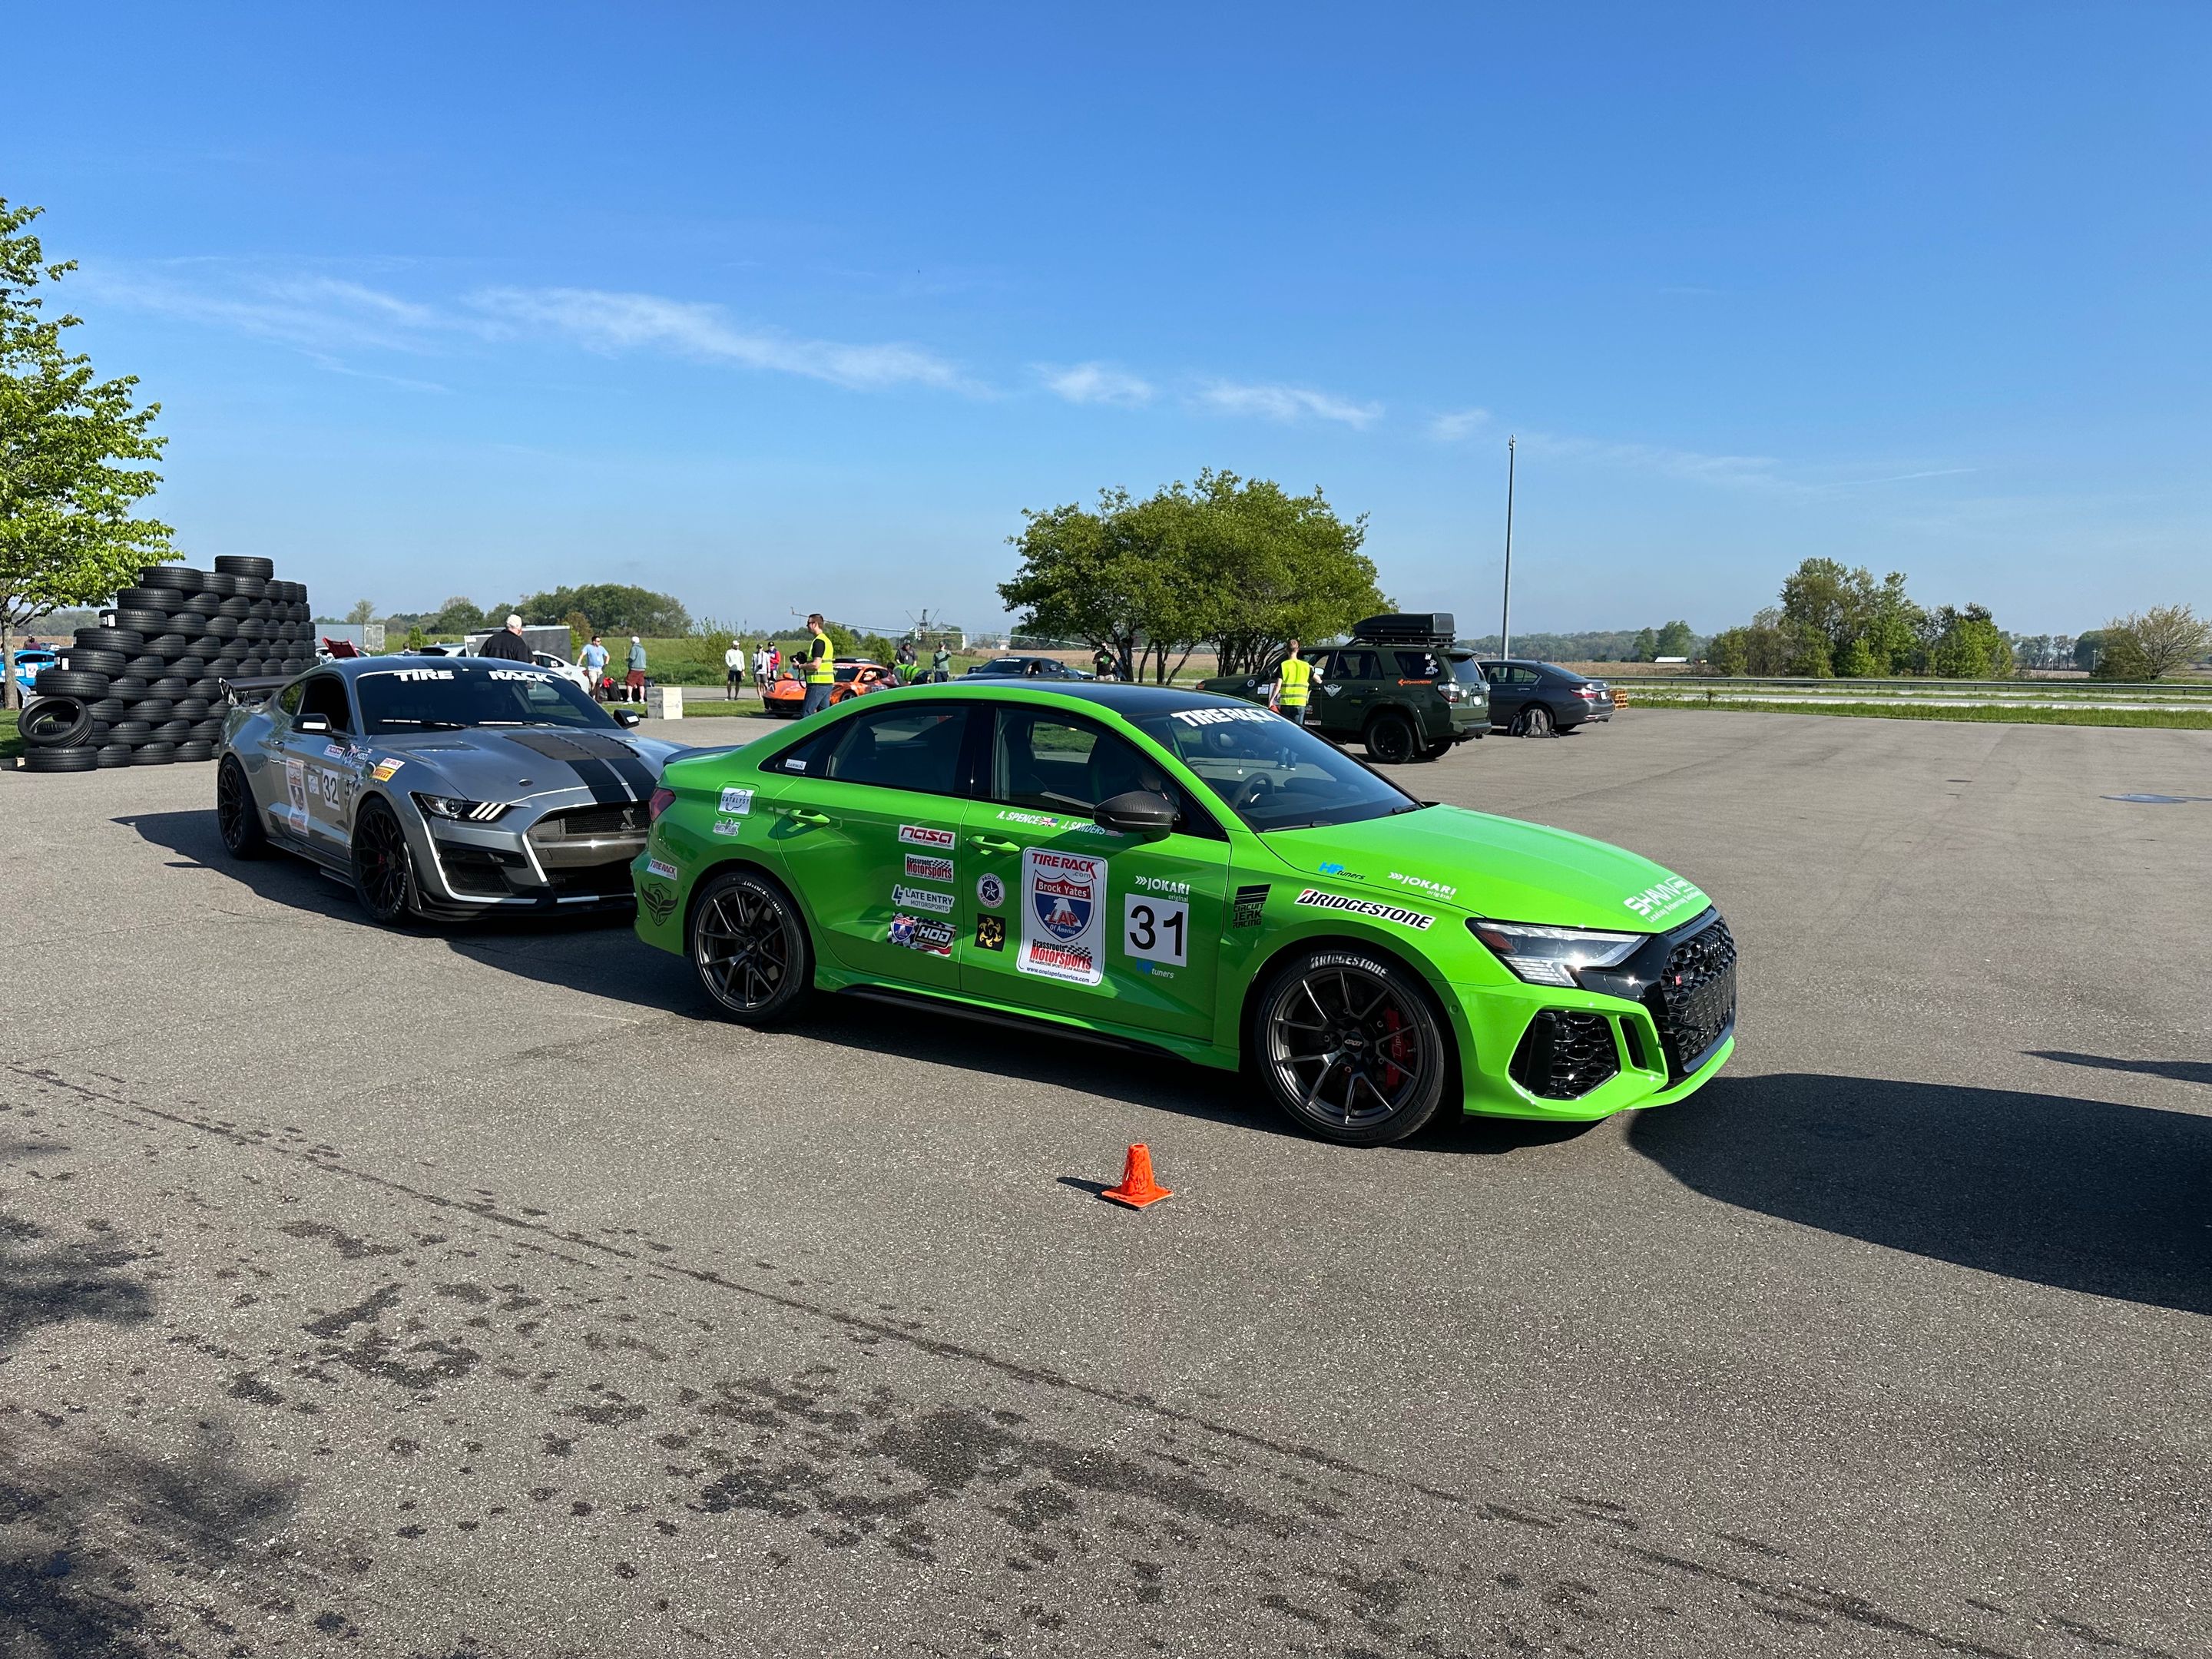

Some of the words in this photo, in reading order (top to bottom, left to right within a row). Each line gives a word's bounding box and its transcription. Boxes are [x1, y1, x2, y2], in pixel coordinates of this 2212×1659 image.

[394, 670, 454, 681] TIRE
[488, 671, 553, 683] RACK
[1170, 708, 1233, 727] TIRE
[1223, 708, 1281, 723] RACK
[323, 775, 339, 804] 32
[722, 796, 750, 805] CATALYST
[996, 810, 1005, 820] A.
[1005, 812, 1041, 825] SPENCE
[1060, 820, 1068, 830] J.
[1068, 822, 1105, 835] SANDERS
[901, 827, 953, 843] nasa
[907, 862, 952, 879] Motorsports
[1032, 853, 1060, 867] TIRE
[1060, 858, 1097, 879] RACK
[1318, 861, 1344, 875] HP
[1336, 869, 1366, 880] tuners
[982, 876, 1001, 884] PROJECT
[1147, 878, 1190, 895] JOKARI
[1401, 876, 1456, 895] JOKARI
[906, 889, 925, 900] LATE
[927, 894, 952, 905] ENTRY
[1038, 881, 1061, 892] Brock
[1064, 886, 1089, 897] Yates'
[1426, 889, 1453, 900] original
[910, 899, 949, 912] MOTORSPORTS
[979, 892, 1002, 906] MOTORING
[1233, 902, 1266, 912] CIRCUIT
[1233, 909, 1262, 922] JERK
[1296, 889, 1433, 929] BRIDGESTONE
[1047, 909, 1078, 928] LAP
[1233, 919, 1261, 928] RACING
[1057, 926, 1075, 935] America
[1129, 905, 1184, 956] 31
[1032, 939, 1065, 952] Grassroots
[1030, 945, 1093, 970] Motorsports
[1311, 953, 1388, 978] BRIDGESTONE
[1026, 967, 1090, 983] www.onelapofamerica.com
[1151, 968, 1174, 979] tuners
